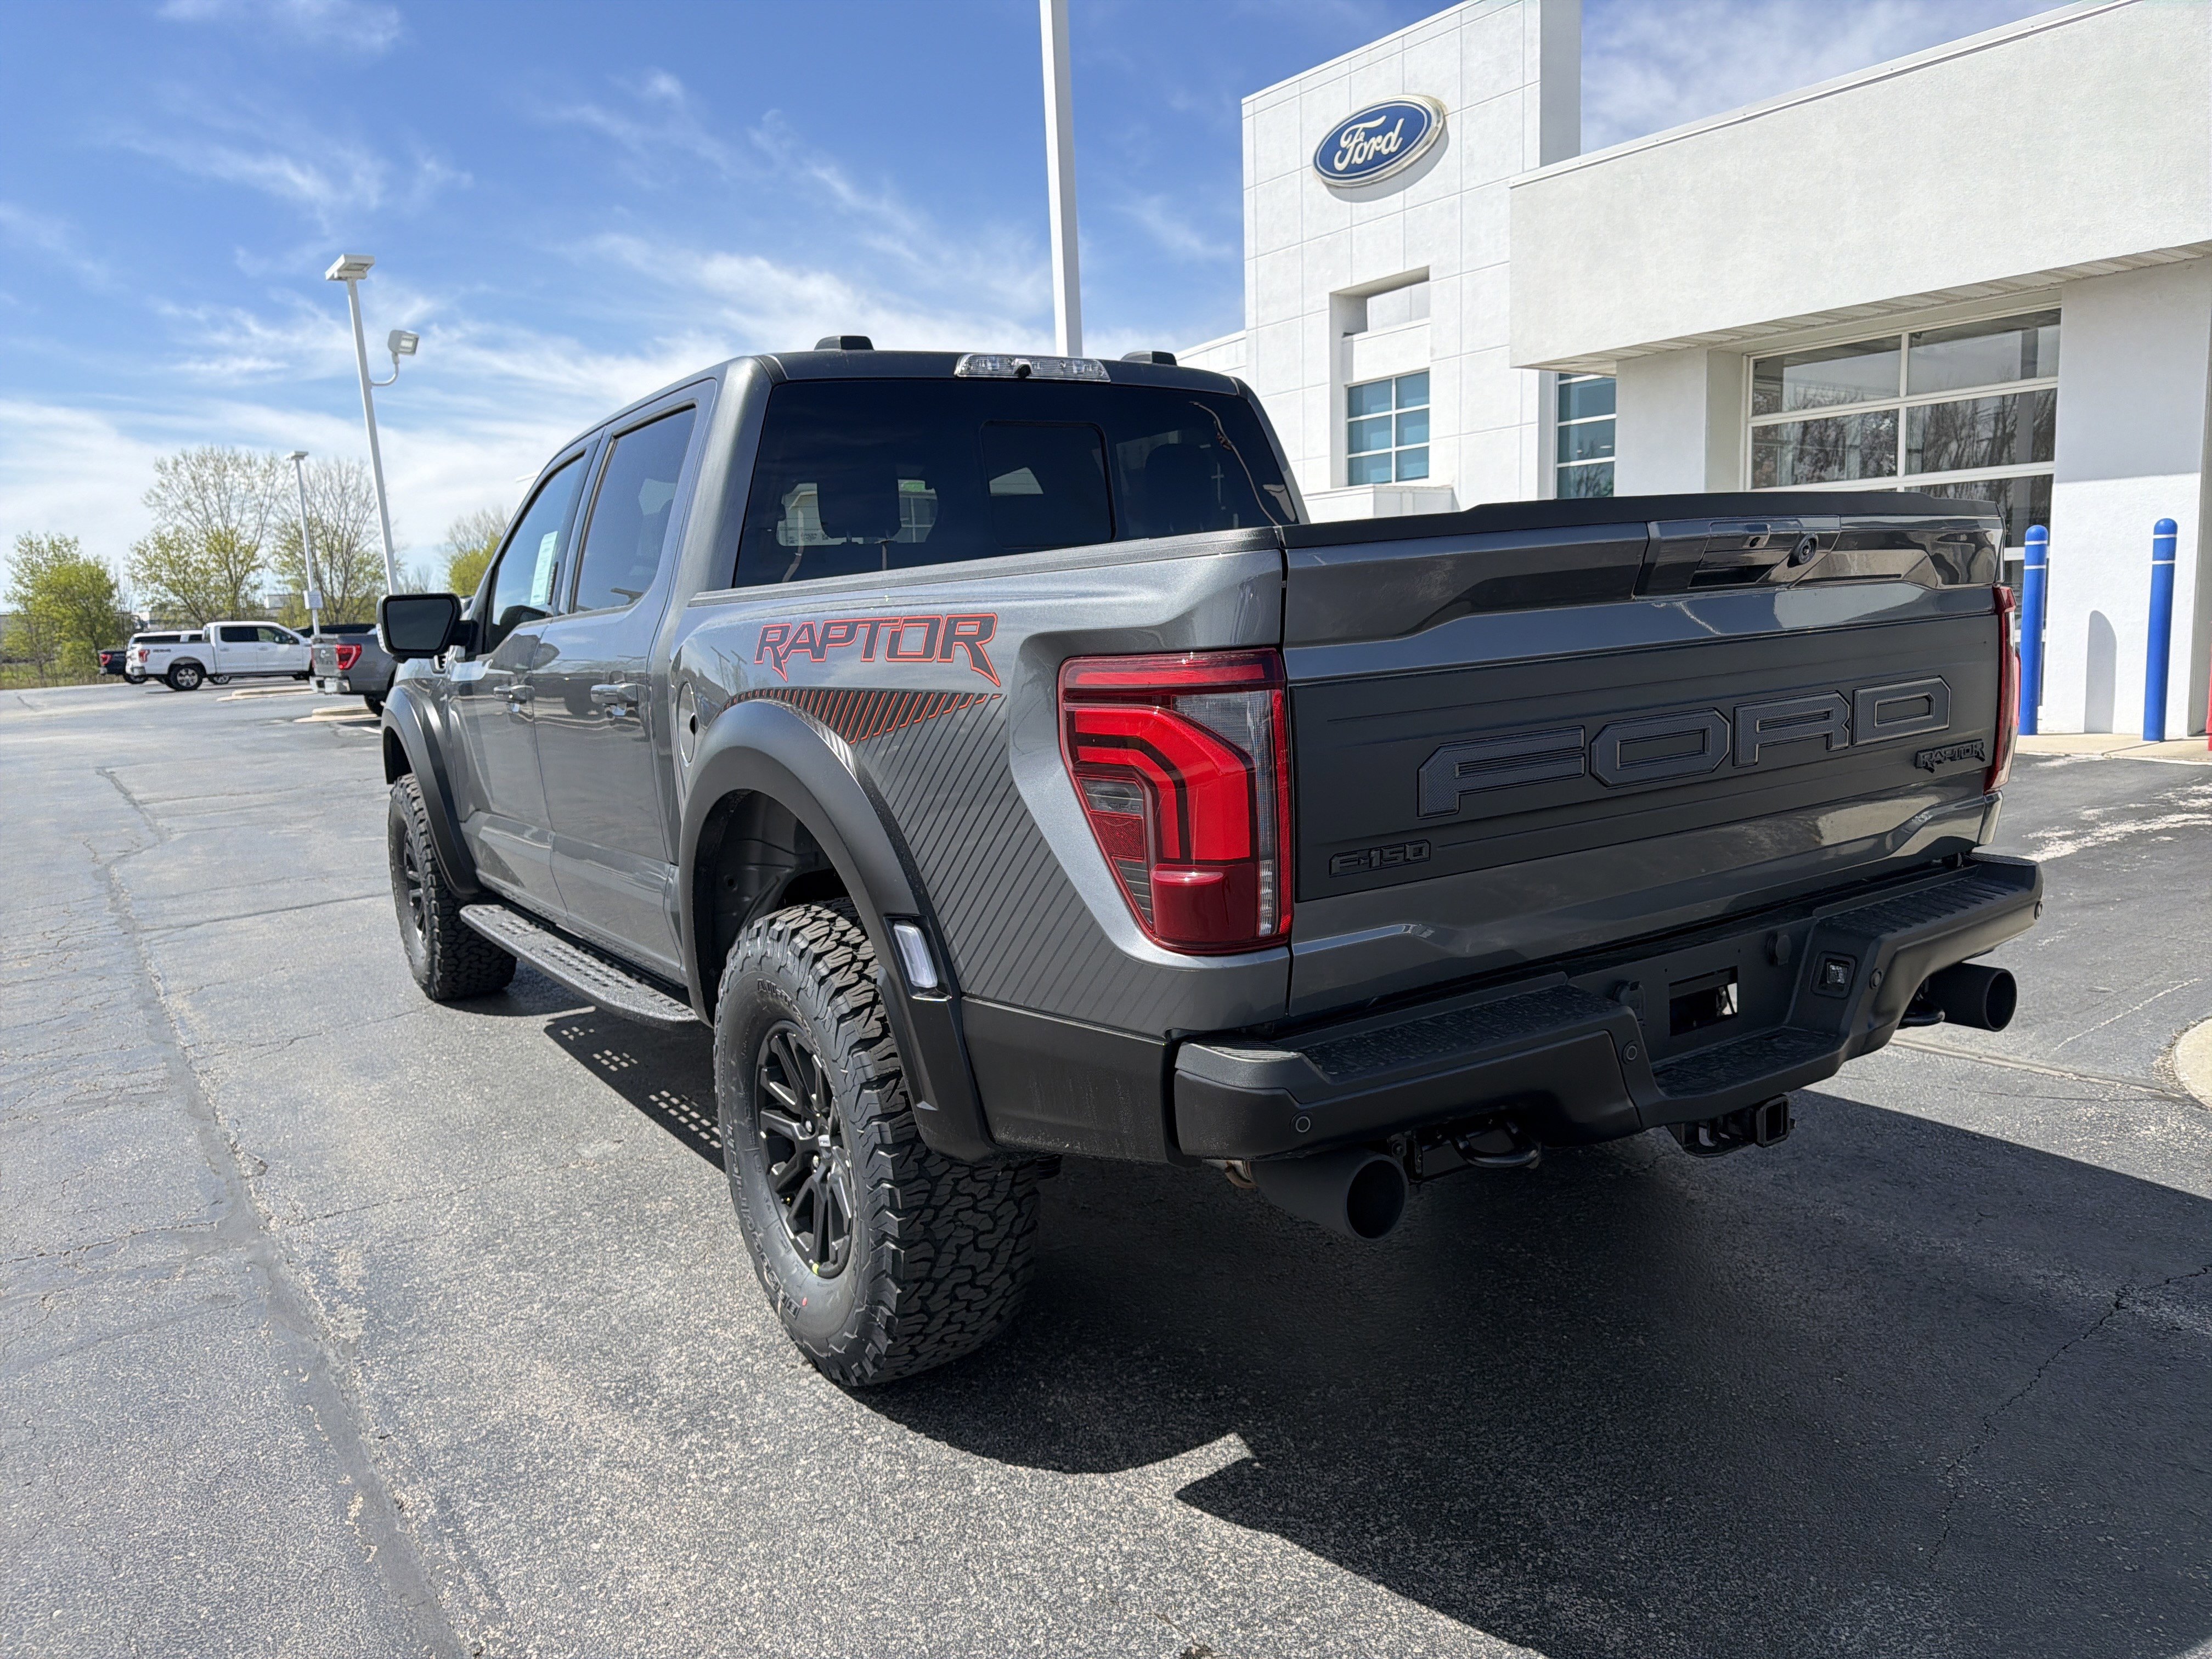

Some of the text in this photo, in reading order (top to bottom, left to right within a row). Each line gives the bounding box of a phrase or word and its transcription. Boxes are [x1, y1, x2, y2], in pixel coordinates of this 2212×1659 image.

[1334, 115, 1405, 171] Ford
[754, 612, 1001, 688] RAPTOR
[1417, 675, 1952, 820] FORD
[1915, 738, 1986, 773] RAPTOR
[1329, 839, 1431, 877] F-150
